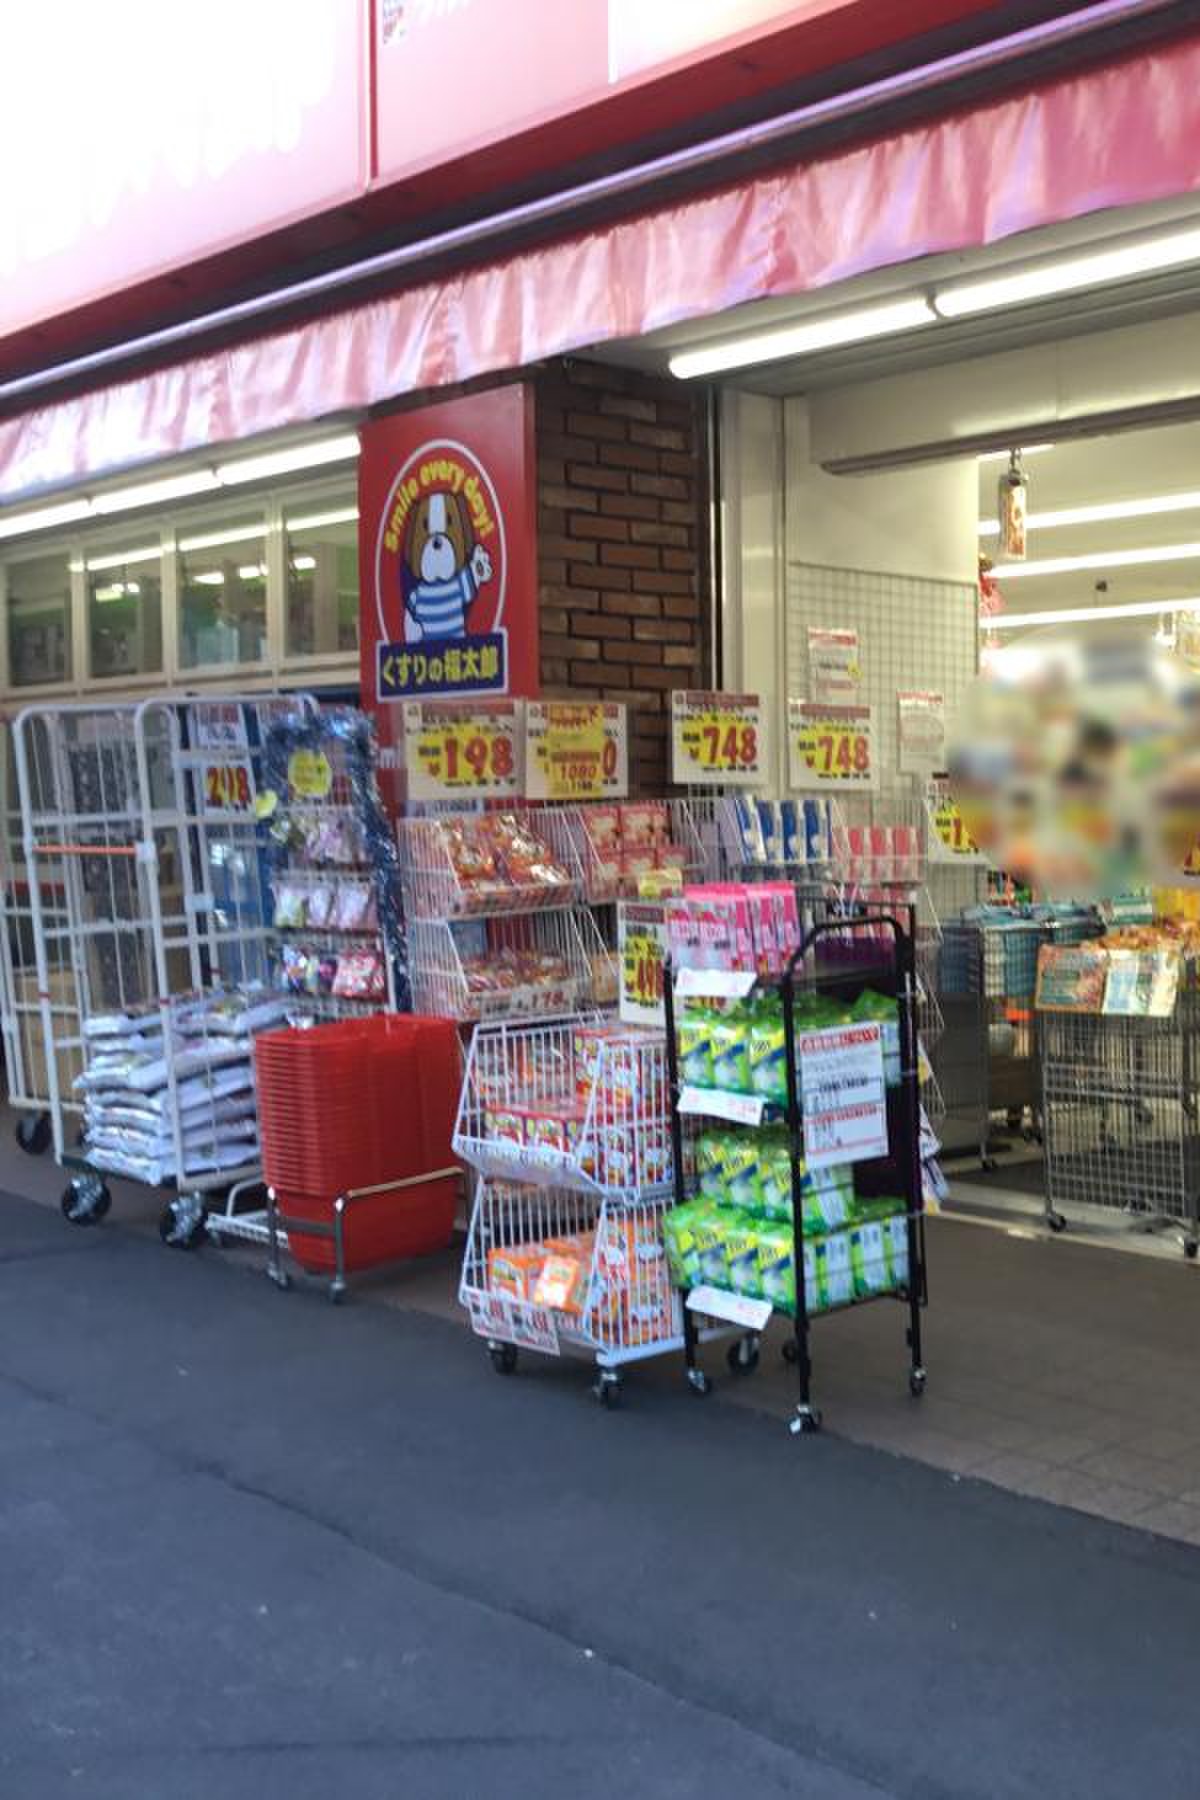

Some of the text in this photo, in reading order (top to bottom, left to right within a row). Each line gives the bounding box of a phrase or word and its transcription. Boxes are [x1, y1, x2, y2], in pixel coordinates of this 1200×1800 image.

[383, 645, 499, 686] くすりの福太郎
[444, 735, 513, 778] 198
[703, 725, 757, 764] 748
[818, 735, 869, 771] 748
